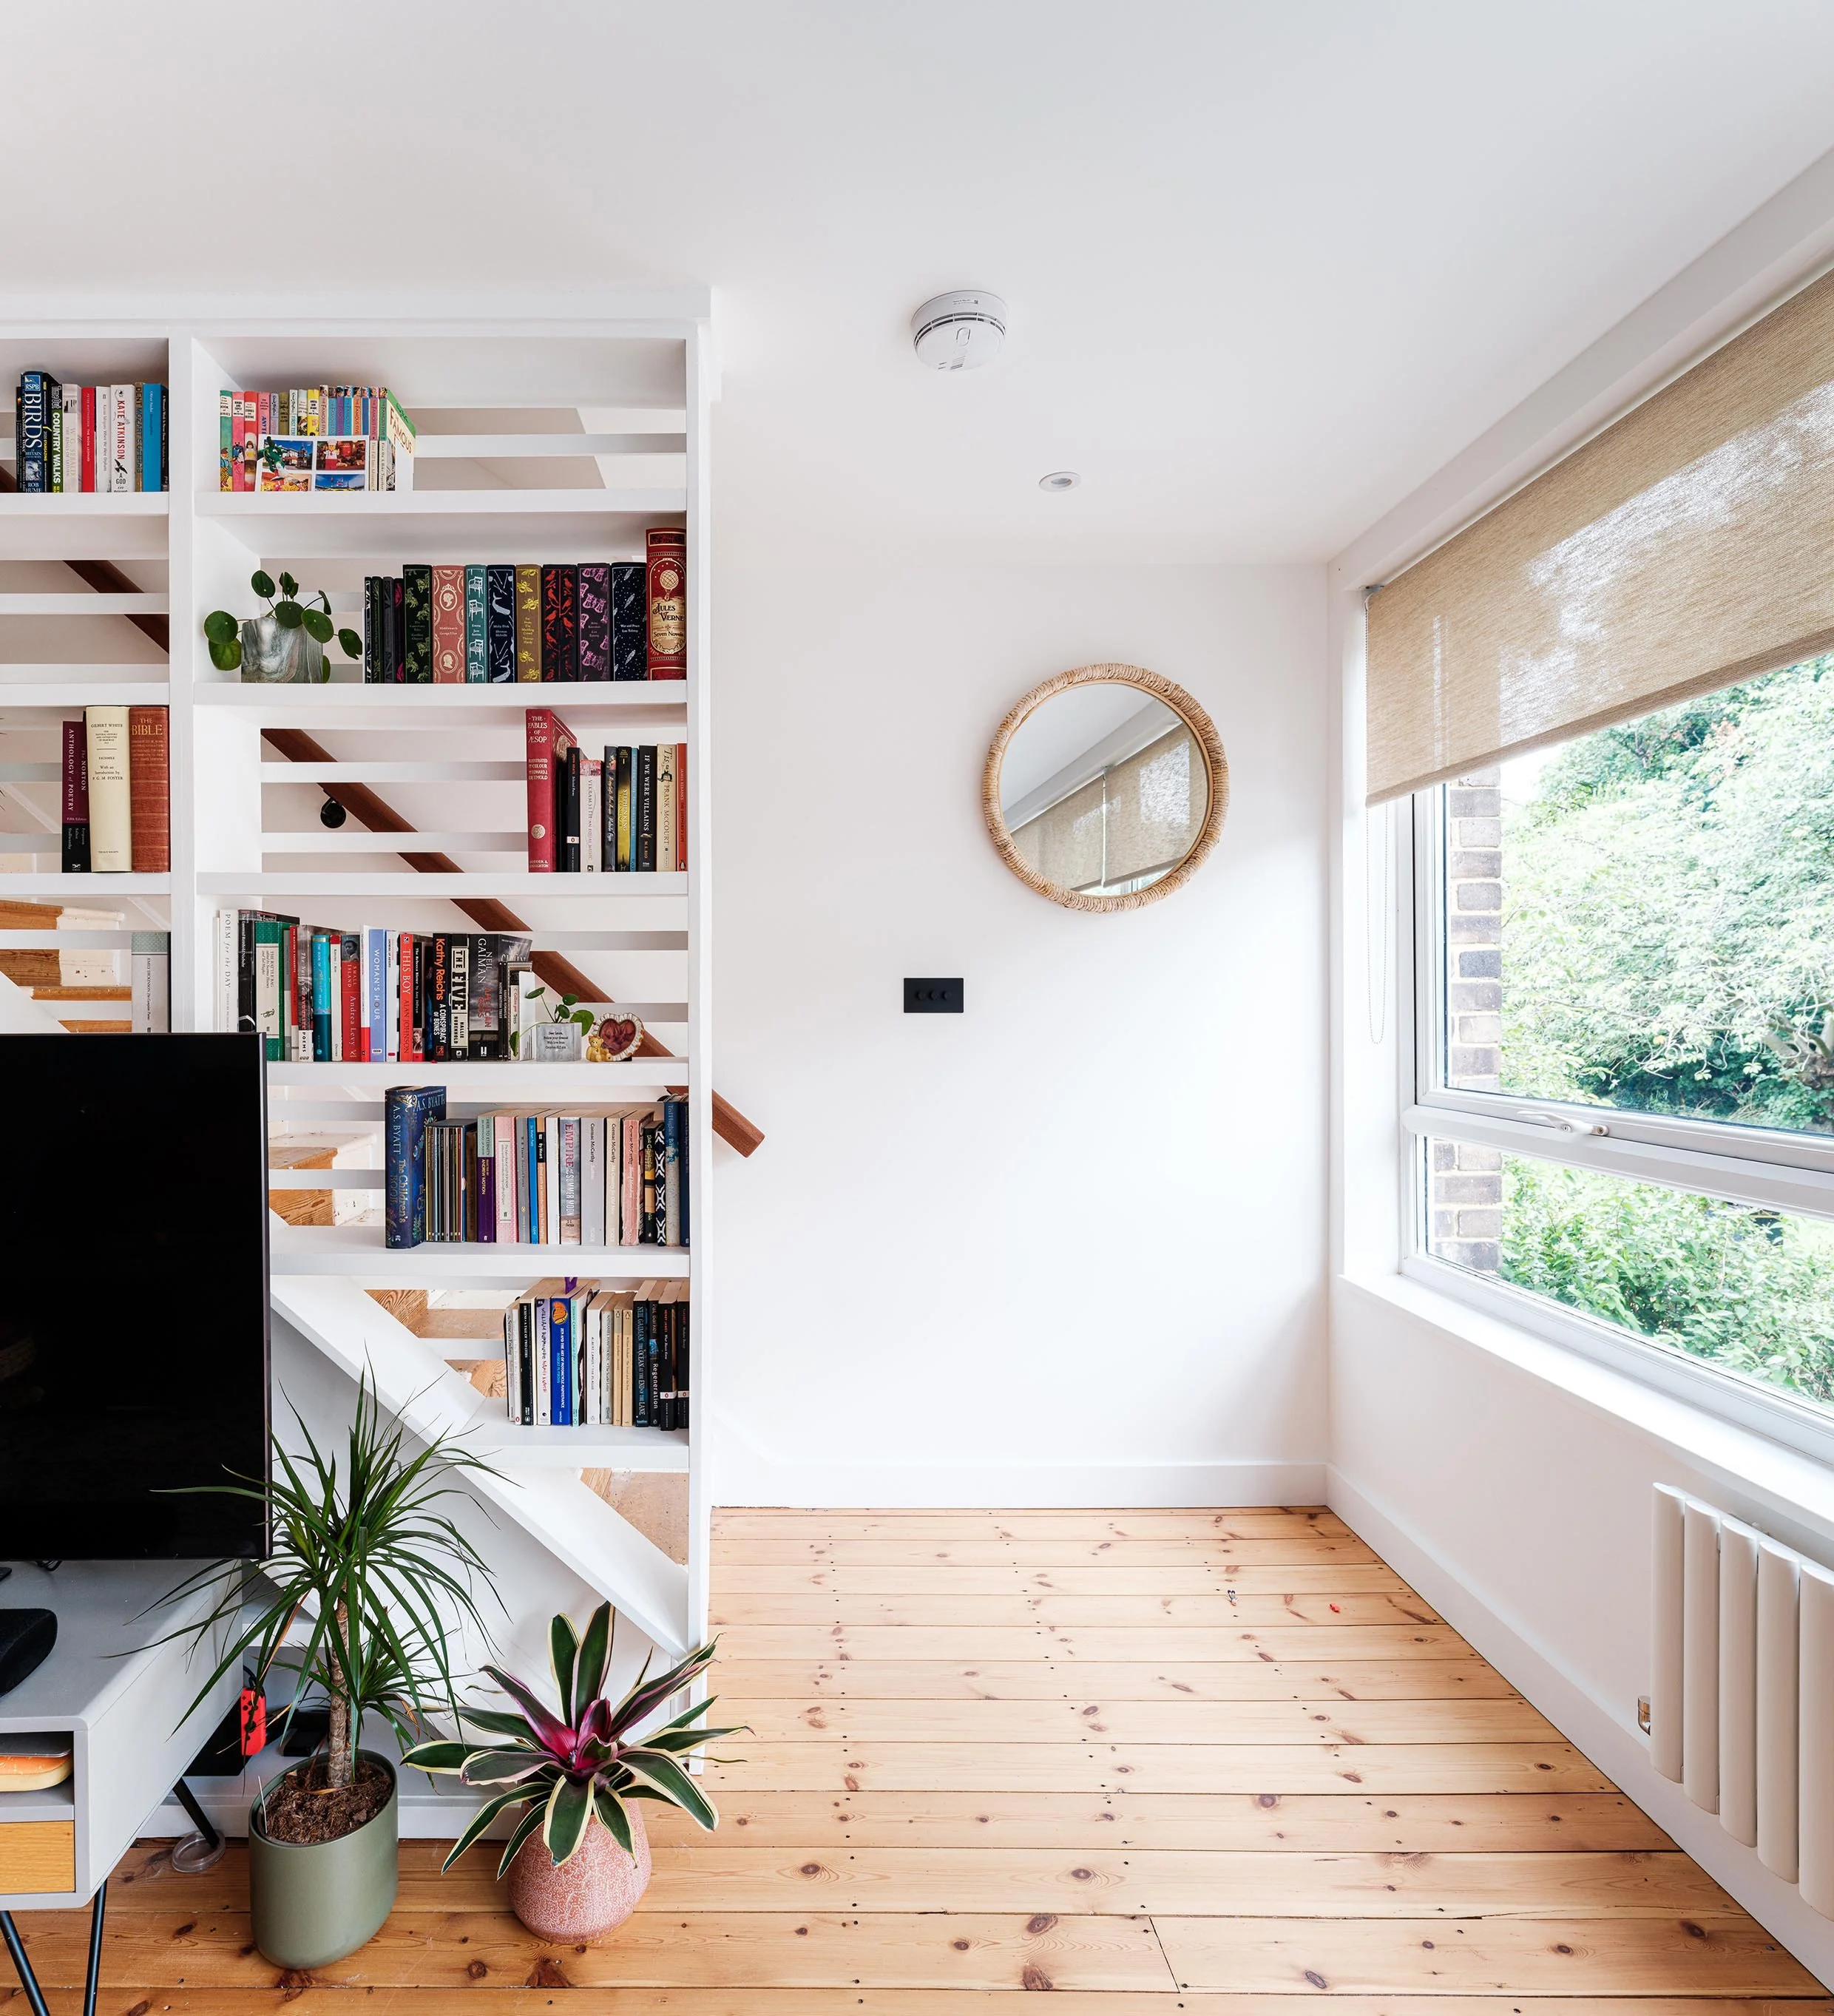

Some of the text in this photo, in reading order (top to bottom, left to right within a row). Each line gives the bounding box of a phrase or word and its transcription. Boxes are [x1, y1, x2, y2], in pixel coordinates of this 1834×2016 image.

[24, 393, 42, 448] BIRDS
[53, 412, 61, 452] COUNTRY
[117, 400, 125, 460] KATE ATKINSON
[390, 407, 412, 453] FAMOUS
[53, 453, 61, 483] WALKS
[653, 603, 676, 615] JULES
[660, 612, 685, 622] VERNE
[132, 725, 163, 735] BIBLE
[643, 754, 650, 762] IF
[643, 763, 650, 775] WE
[587, 819, 594, 828] AN
[402, 949, 411, 995] THIS BOY
[434, 938, 445, 1001] Kathy Reichs
[478, 938, 487, 984] GAIMAN
[452, 971, 467, 1010] FIVE
[348, 995, 356, 1046] Andrea Levy
[427, 1094, 444, 1109] BYATT
[393, 1105, 401, 1154] A.S. BYATT
[565, 1123, 574, 1167] EMPIRE
[399, 1175, 408, 1223] Children's
[566, 1174, 575, 1216] SUMMER MOON
[650, 1363, 659, 1409] Regeneration
